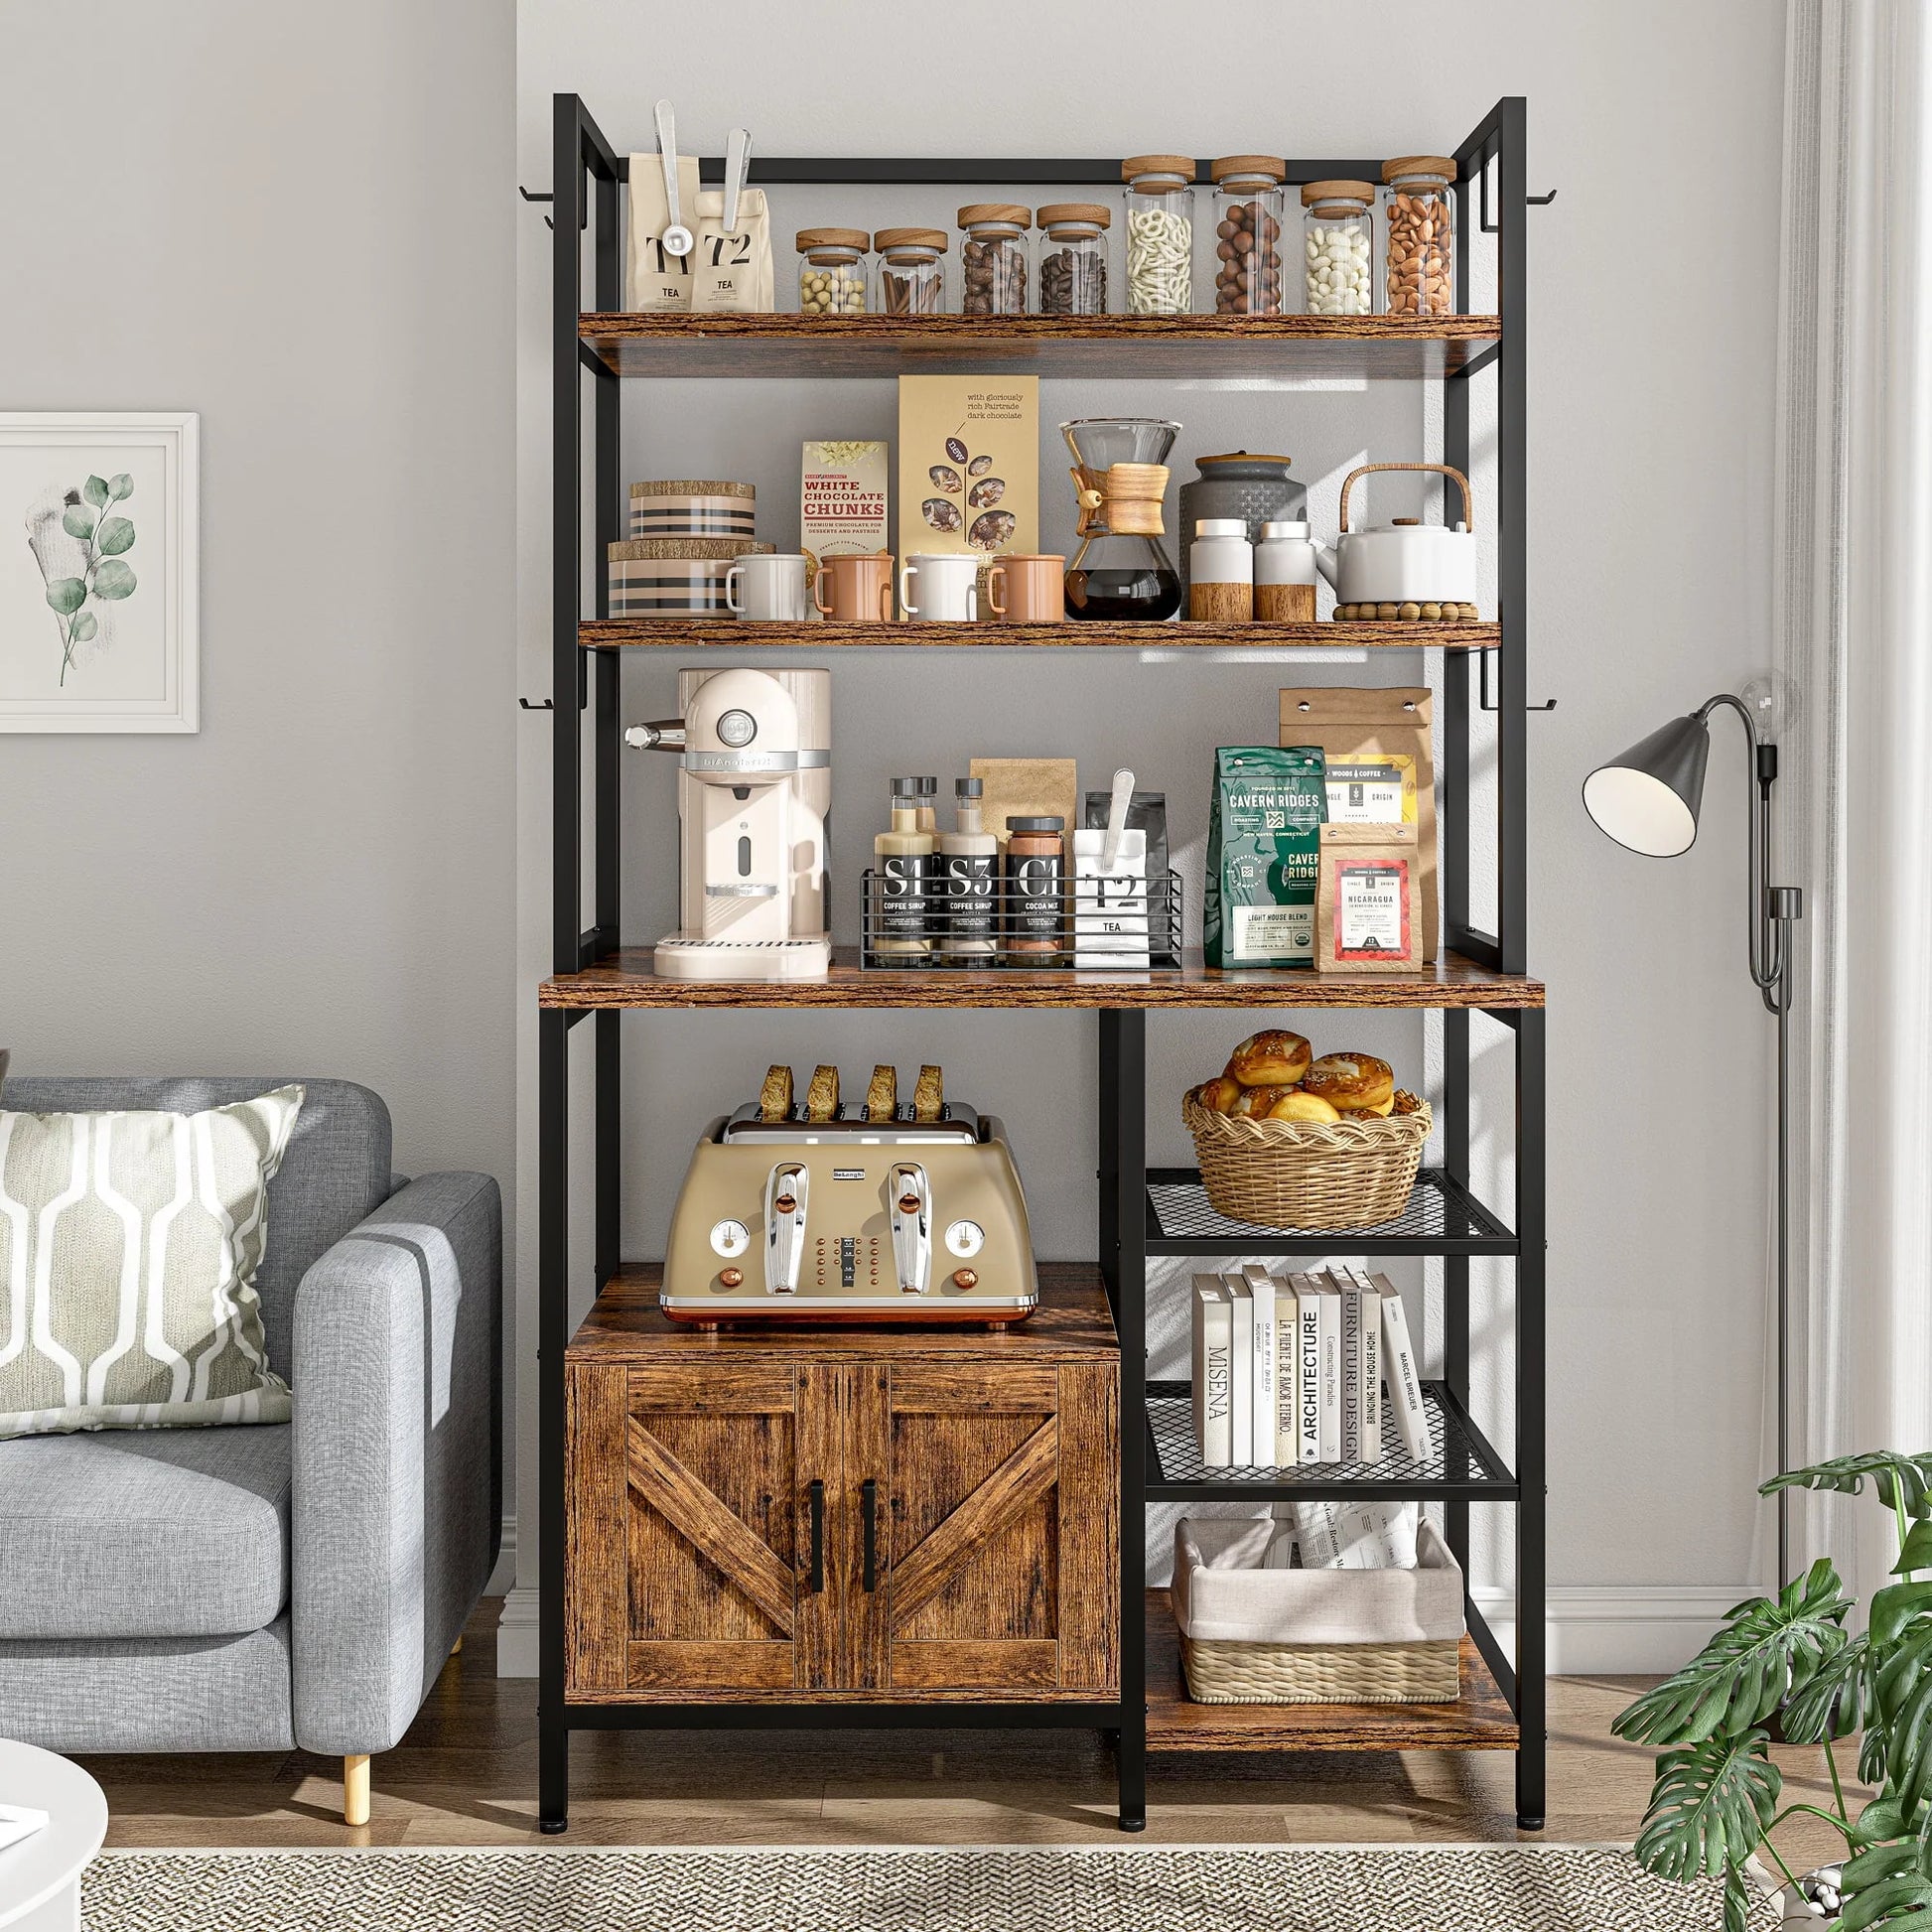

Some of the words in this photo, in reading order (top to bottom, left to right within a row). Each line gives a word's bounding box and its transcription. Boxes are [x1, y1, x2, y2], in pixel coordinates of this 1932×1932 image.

[704, 234, 751, 267] T2
[662, 288, 680, 298] TEA
[717, 280, 733, 290] TEA
[948, 441, 965, 461] new
[804, 482, 860, 490] WHITE
[804, 503, 885, 515] CHUNKS
[1230, 794, 1275, 808] CAVERN
[1278, 794, 1319, 808] RIDGES
[1289, 853, 1318, 865] CAVER
[883, 859, 925, 897] S1
[947, 859, 993, 897] S3
[1019, 859, 1060, 897] C1
[1289, 867, 1318, 879] RIDG
[884, 901, 907, 910] COFFEE
[907, 901, 926, 910] SIRUP
[950, 901, 974, 910] COFFEE
[974, 901, 992, 910] SIRUP
[1047, 901, 1058, 910] MIX
[1102, 922, 1121, 932] TEA
[1247, 913, 1267, 922] LIGHT
[1279, 1318, 1296, 1329] LA
[1279, 1332, 1292, 1360] FUENTE
[1346, 1292, 1357, 1392] FURNITURE
[1366, 1330, 1376, 1351] HOME
[1324, 1335, 1335, 1378] Constructing
[1366, 1351, 1376, 1375] HOUSE
[1279, 1362, 1292, 1373] DE
[1304, 1311, 1317, 1441] ARCHITECTURE
[1208, 1346, 1228, 1421] MISENA
[1279, 1376, 1292, 1401] AMOR
[1366, 1376, 1376, 1390] THE
[1399, 1351, 1411, 1382] MARCEL
[1405, 1381, 1418, 1412] BREUER
[1366, 1391, 1376, 1425] BRINGING
[1346, 1398, 1357, 1460] DESIGN
[1329, 1529, 1340, 1558] Restore
